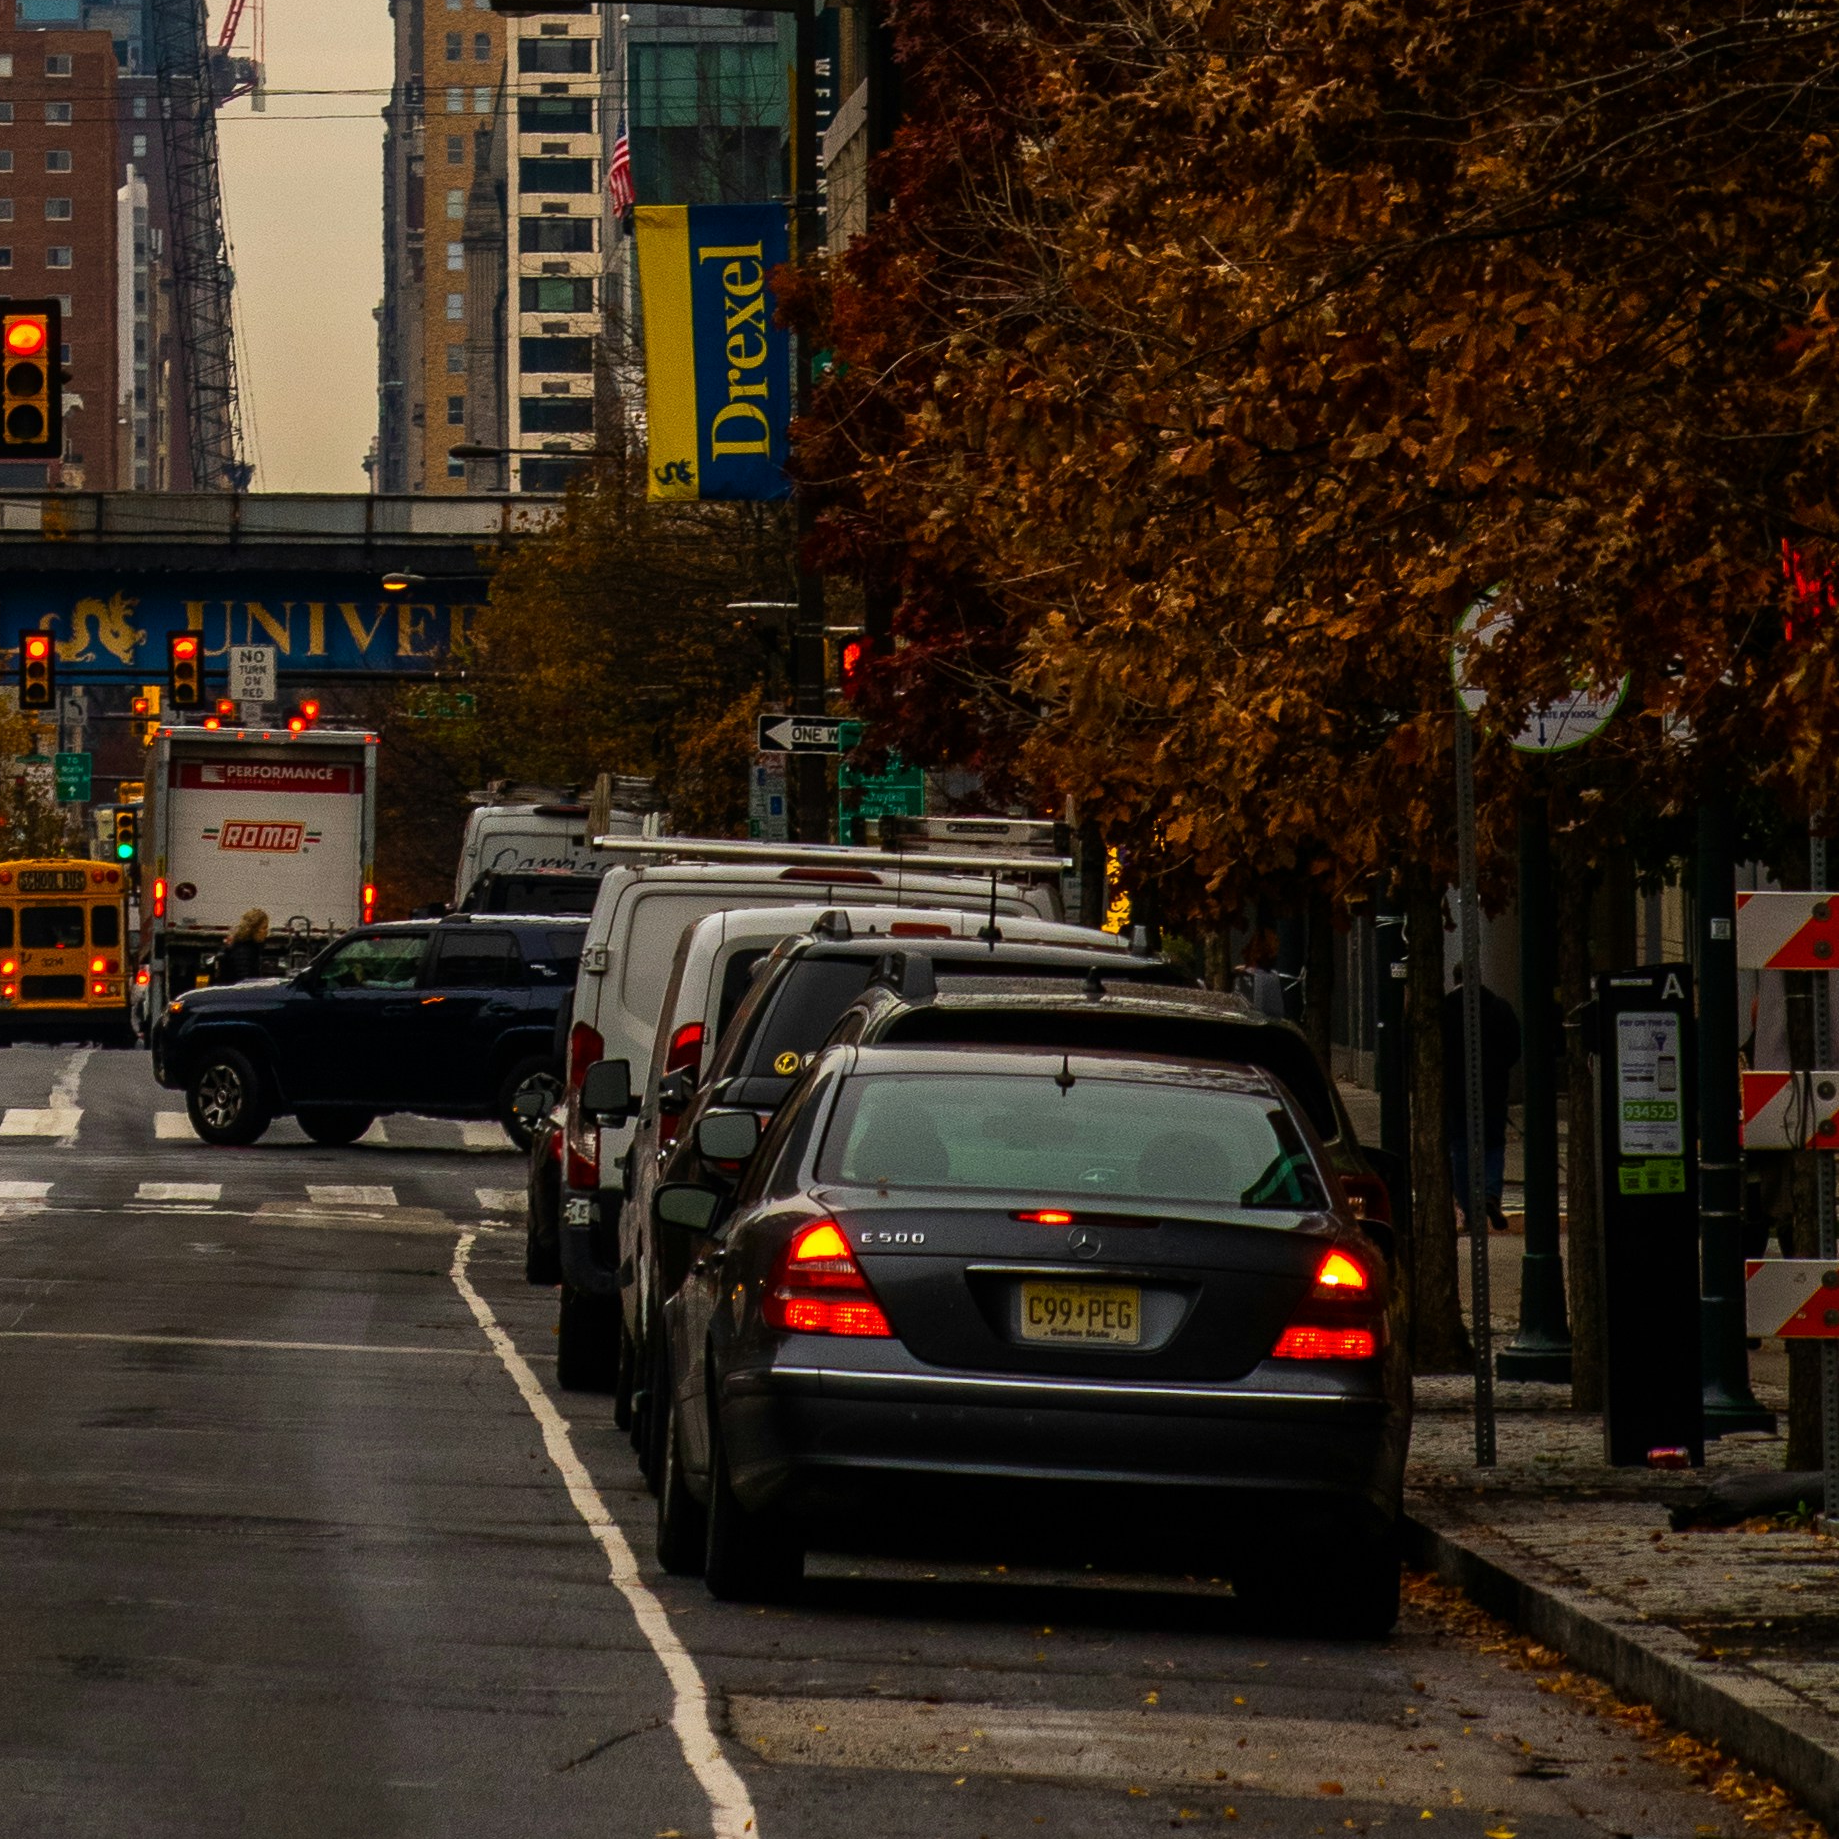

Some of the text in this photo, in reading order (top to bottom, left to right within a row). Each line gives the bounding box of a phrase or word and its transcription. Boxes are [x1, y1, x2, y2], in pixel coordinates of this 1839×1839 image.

[698, 240, 771, 463] Drexel
[240, 650, 265, 663] NO
[239, 665, 267, 675] TURN
[244, 675, 261, 687] ON
[241, 687, 264, 698] RED
[1571, 710, 1597, 720] KIOSK
[792, 728, 822, 742] ONE
[226, 765, 334, 782] PERFORMANCE
[224, 825, 299, 848] ROMA
[19, 872, 85, 890] SCHOOL BUS
[1660, 971, 1686, 1001] A
[1624, 1104, 1677, 1119] 934525
[1050, 1327, 1083, 1338] Garden
